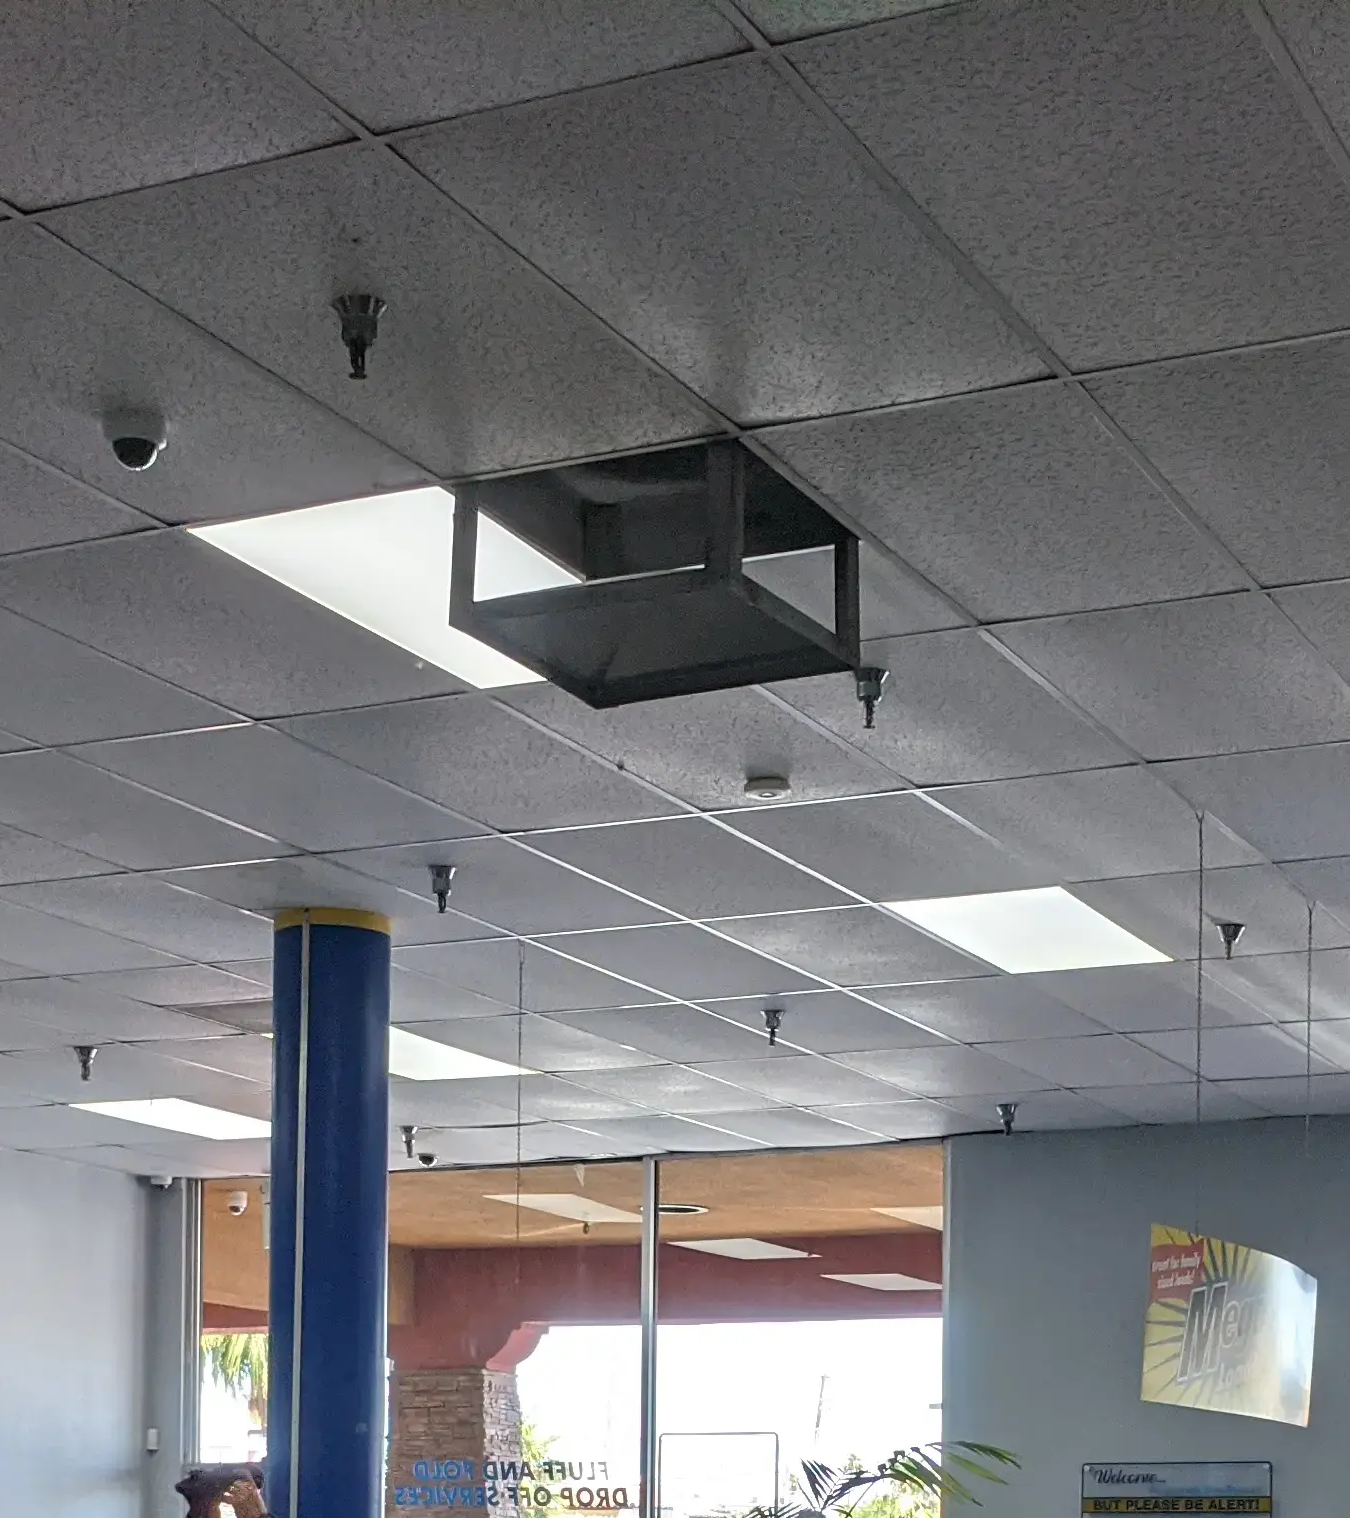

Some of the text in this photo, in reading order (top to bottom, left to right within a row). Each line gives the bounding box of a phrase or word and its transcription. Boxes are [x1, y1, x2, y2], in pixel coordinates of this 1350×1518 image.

[1093, 1499, 1260, 1511] BUT PLEASE BE ALERT!
